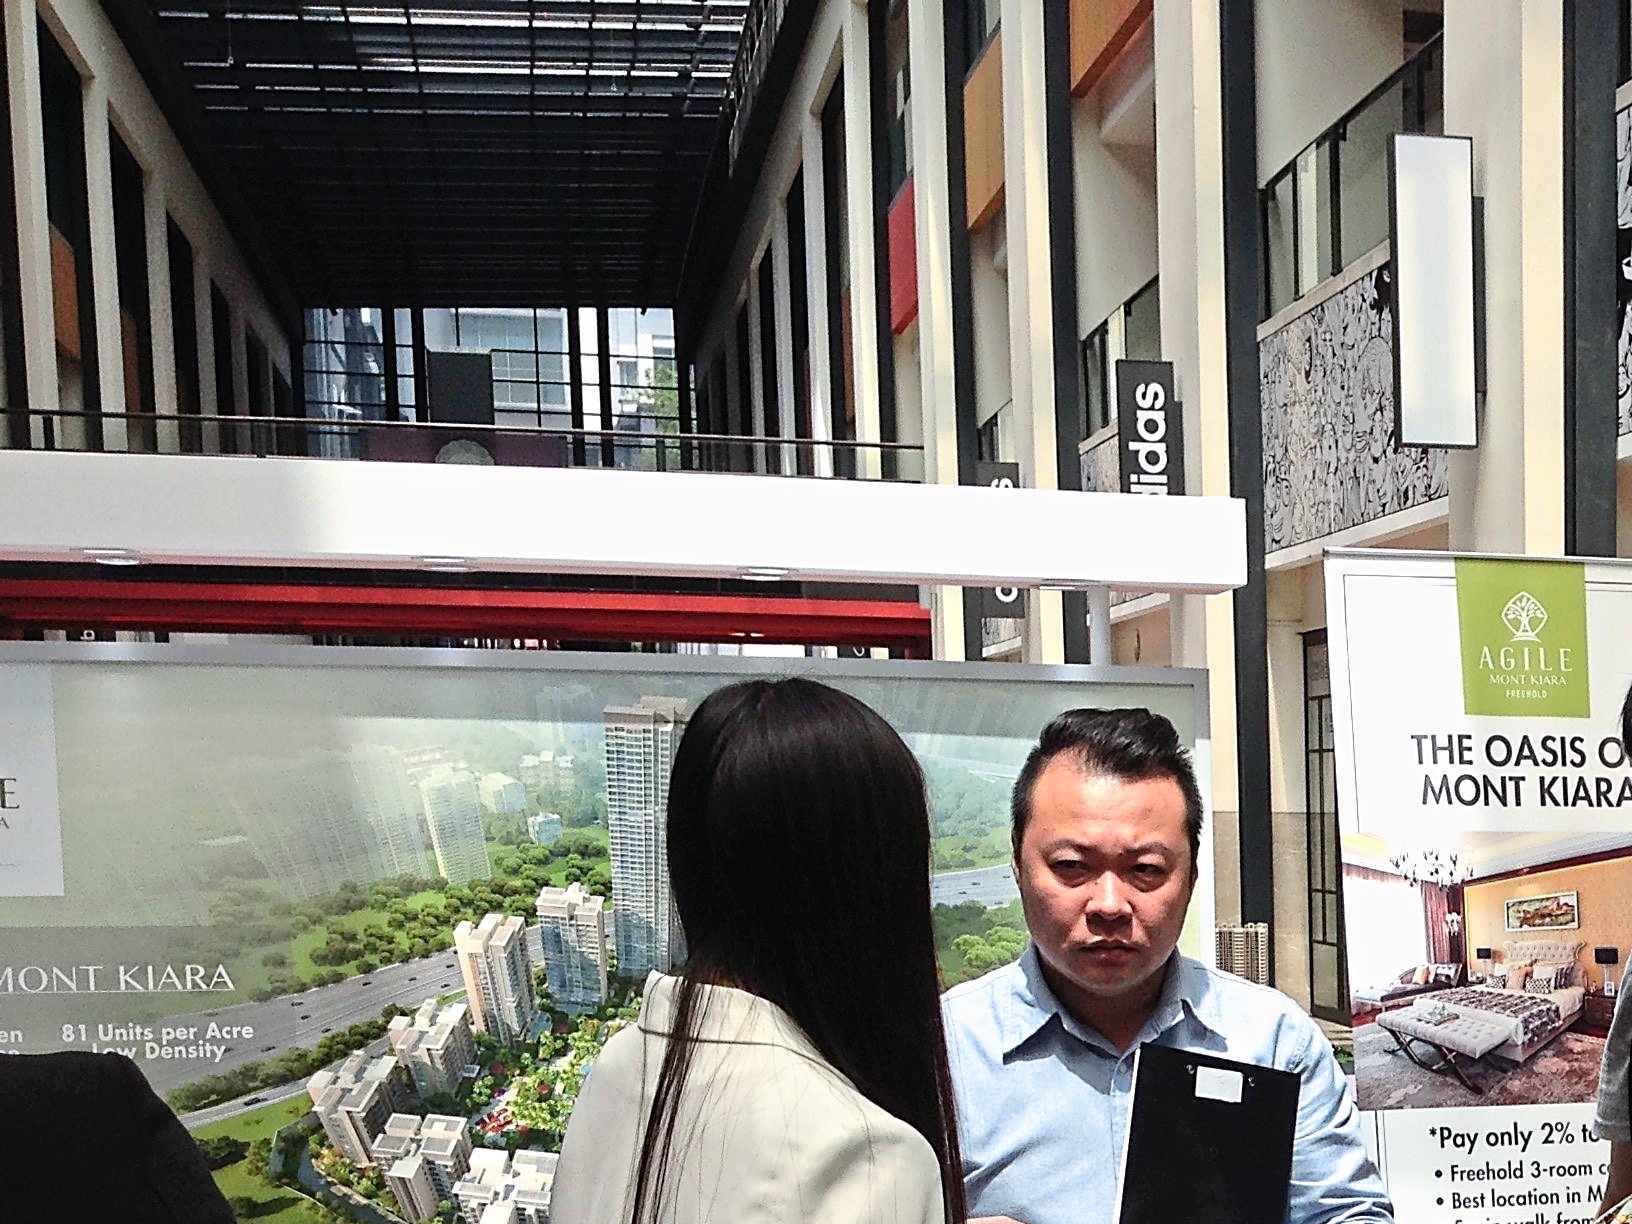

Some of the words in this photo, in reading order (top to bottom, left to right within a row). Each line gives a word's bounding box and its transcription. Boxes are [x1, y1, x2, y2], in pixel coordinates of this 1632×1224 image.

[1479, 645, 1573, 672] AGILE
[1489, 674, 1526, 686] MONT
[1530, 674, 1568, 687] KIARA
[1506, 689, 1548, 699] FREEHOLD
[1411, 734, 1474, 766] THE
[1485, 734, 1587, 769] OASIS
[1598, 736, 1632, 769] O
[1422, 774, 1526, 806] MONT
[119, 964, 235, 991] KIARA
[61, 1024, 88, 1042] 81
[98, 1022, 153, 1042] Units
[161, 1026, 198, 1044] per
[205, 1021, 254, 1040] Acre
[145, 1040, 226, 1062] Density
[1485, 1121, 1533, 1153] only
[1540, 1121, 1575, 1145] 2%
[1450, 1160, 1524, 1182] Freehold
[1530, 1160, 1593, 1178] 3-room
[1452, 1192, 1485, 1209] Best
[1491, 1188, 1560, 1207] location
[1566, 1186, 1581, 1203] in
